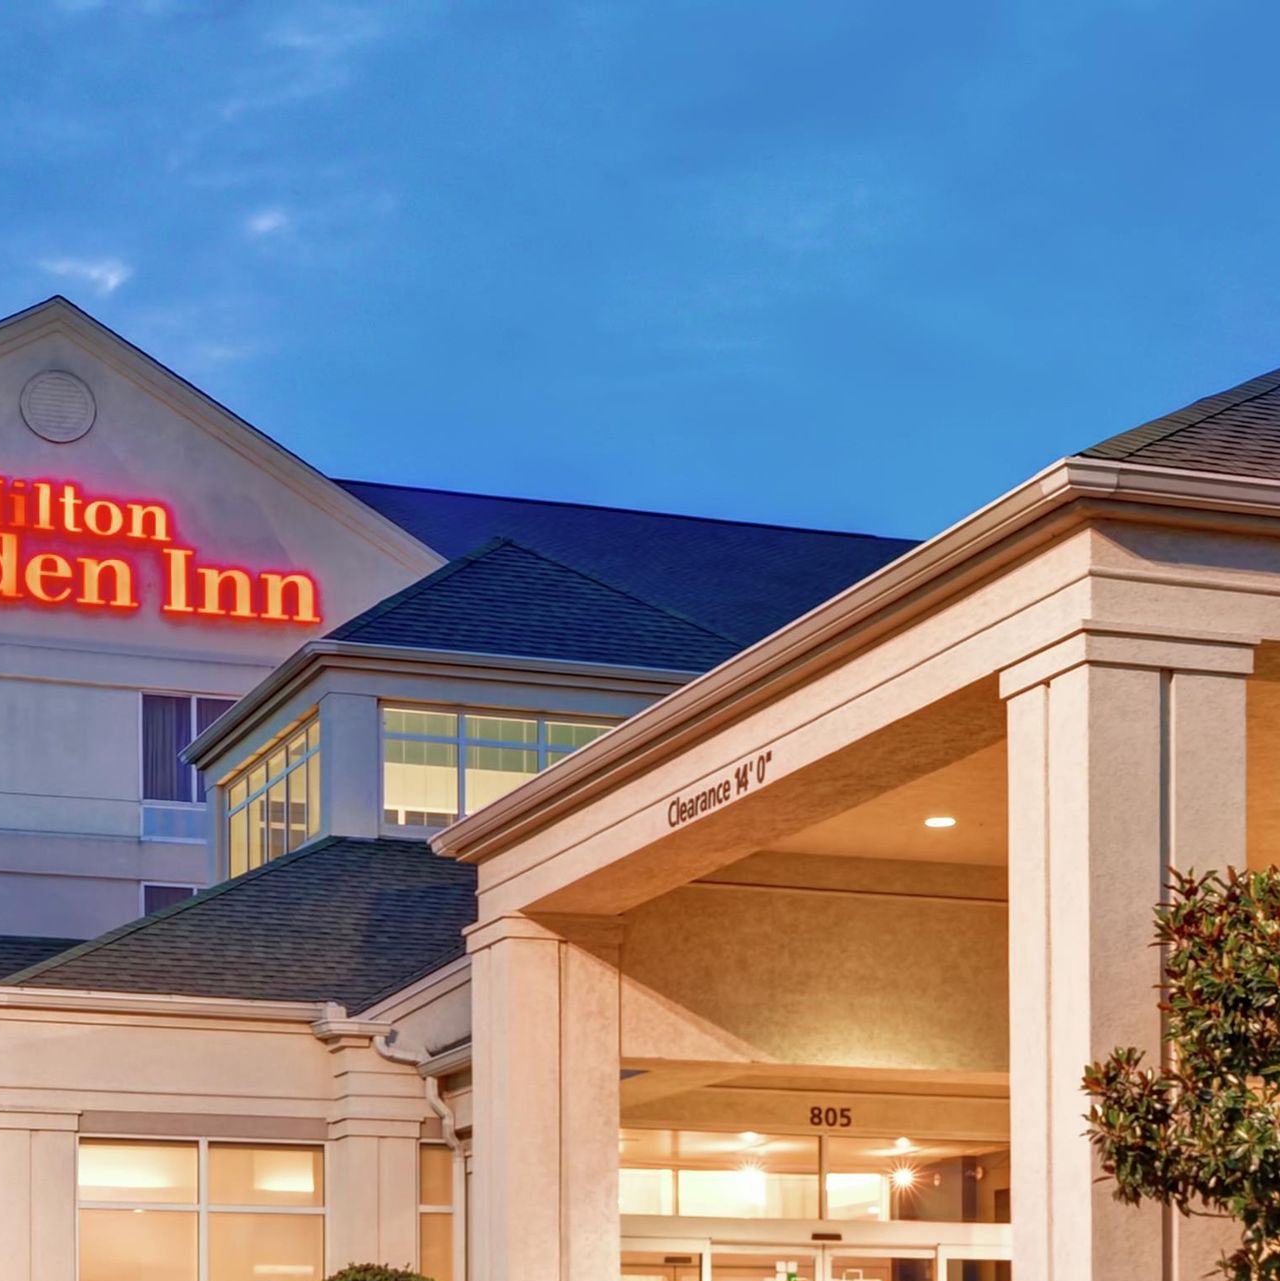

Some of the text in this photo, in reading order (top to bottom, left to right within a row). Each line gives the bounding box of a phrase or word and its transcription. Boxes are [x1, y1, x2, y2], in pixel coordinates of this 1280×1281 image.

[162, 547, 321, 623] Inn
[668, 779, 731, 827] Clearance
[810, 1106, 852, 1128] 805
